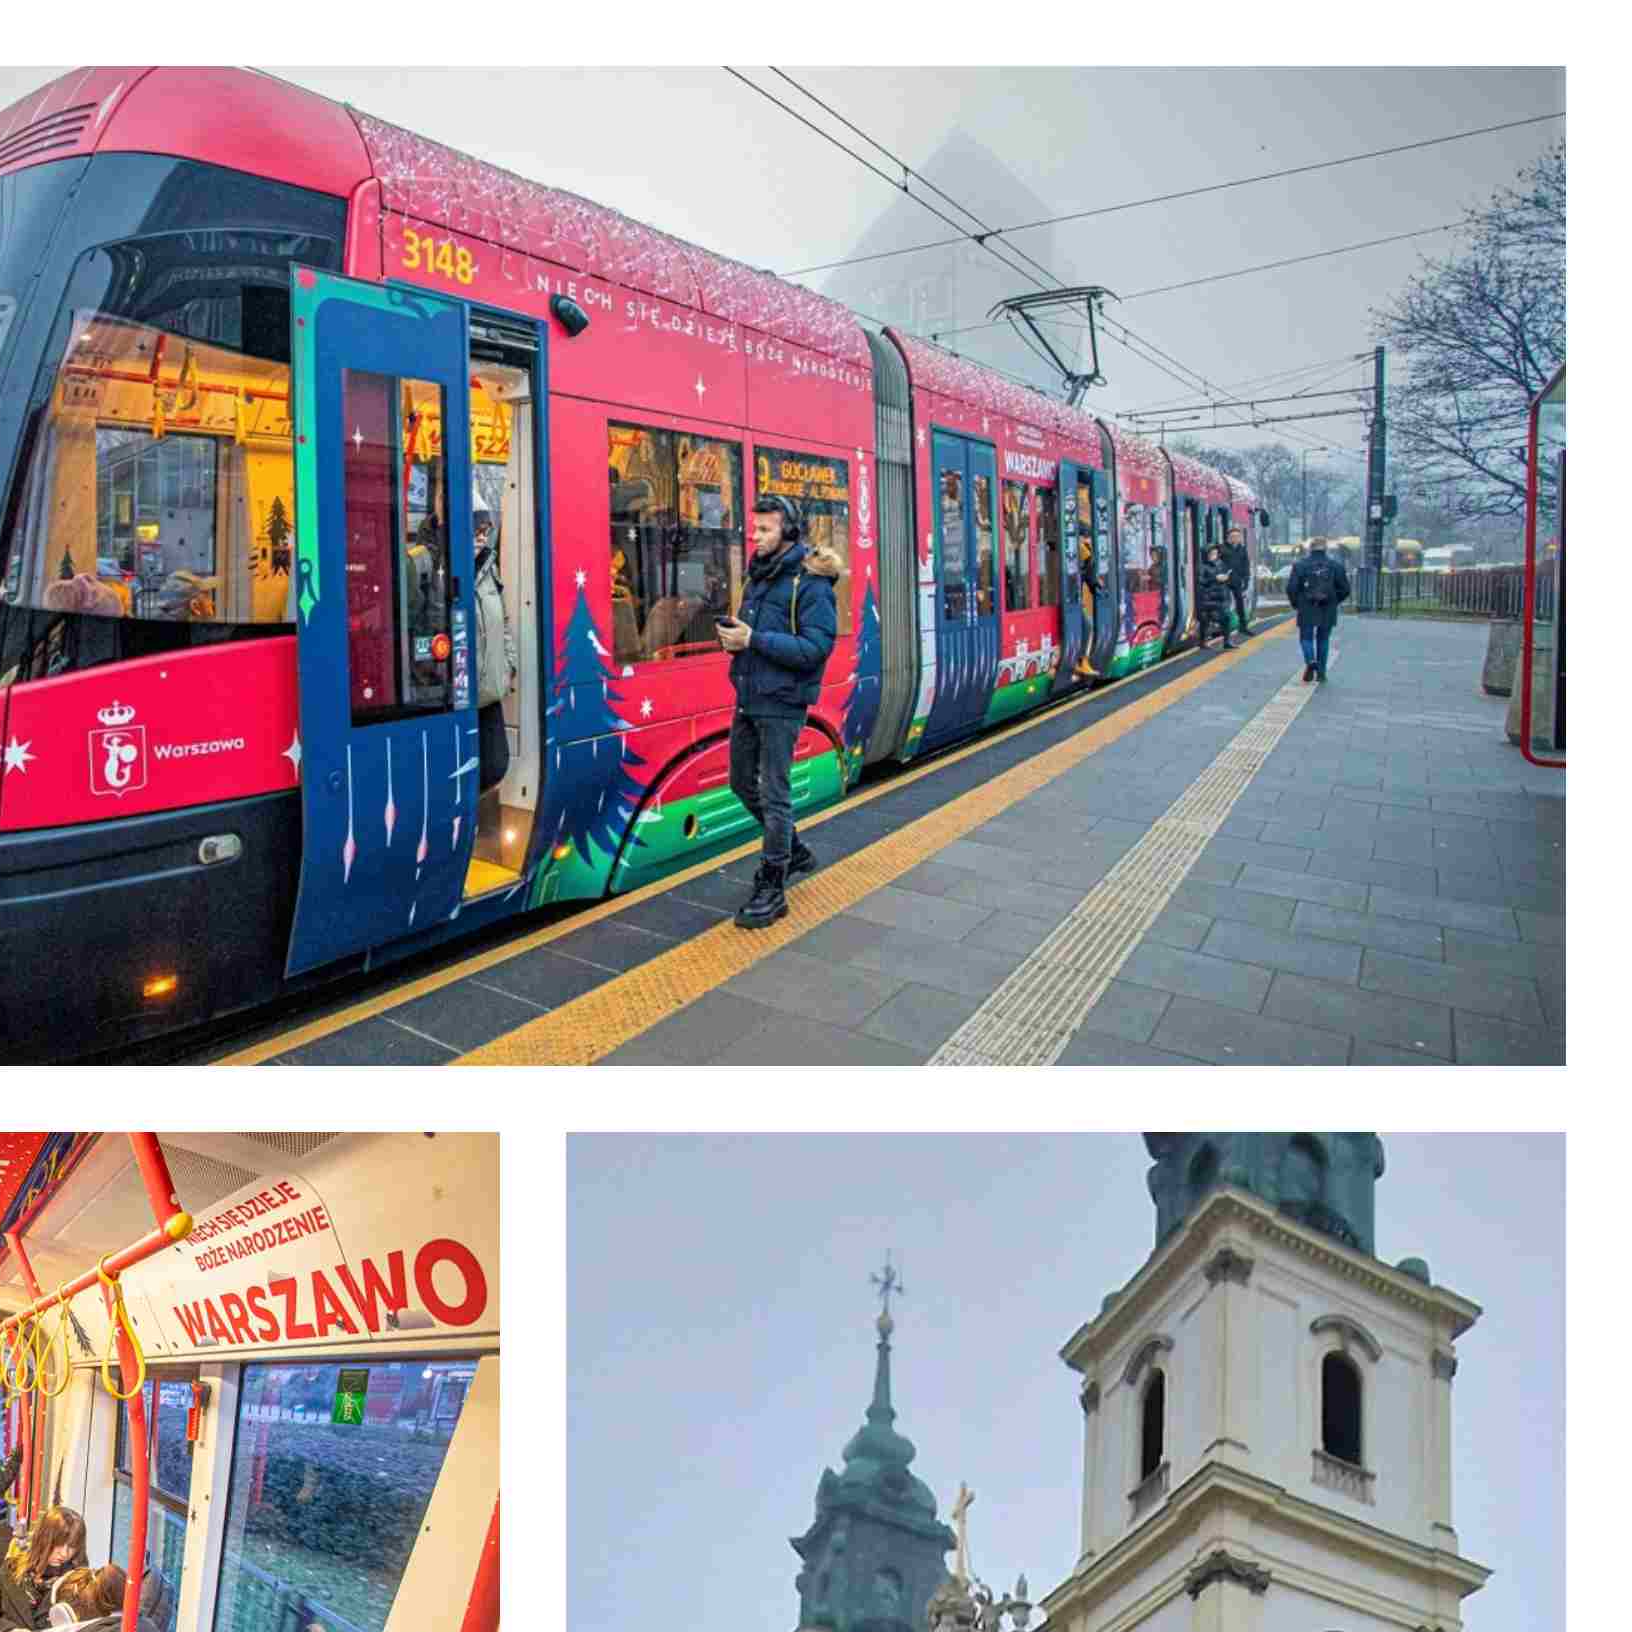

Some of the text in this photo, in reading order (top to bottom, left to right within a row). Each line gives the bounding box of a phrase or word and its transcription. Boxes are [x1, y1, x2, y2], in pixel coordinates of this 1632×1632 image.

[401, 228, 474, 285] 3148
[154, 733, 245, 760] Warszawa
[240, 1181, 302, 1221] DZIEJE
[229, 1205, 330, 1261] NARODZENIE
[173, 1237, 489, 1348] WARSZAWO
